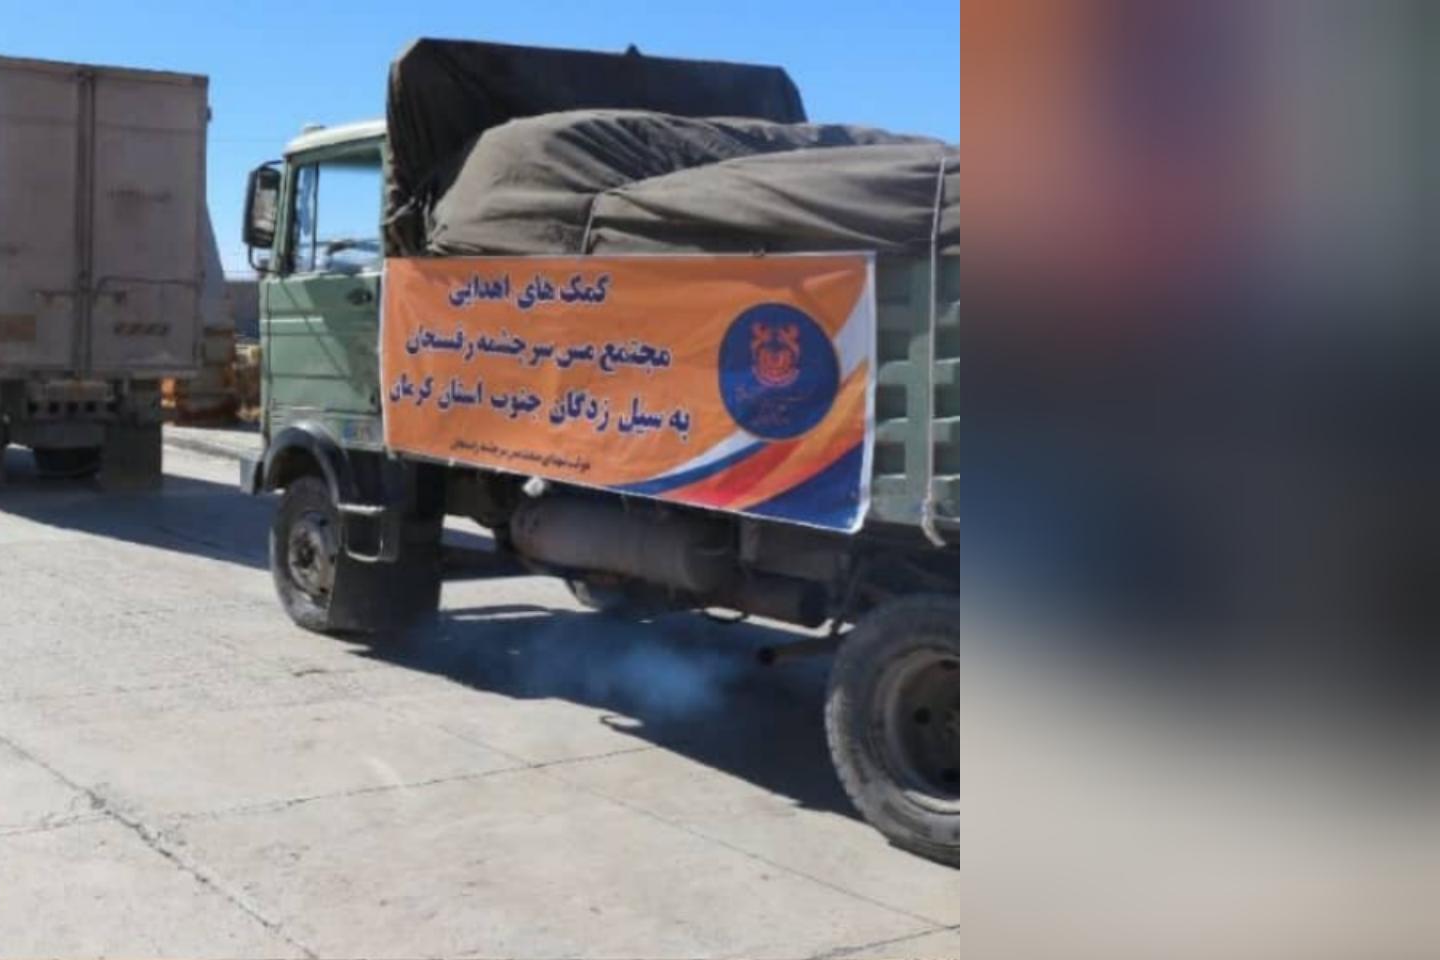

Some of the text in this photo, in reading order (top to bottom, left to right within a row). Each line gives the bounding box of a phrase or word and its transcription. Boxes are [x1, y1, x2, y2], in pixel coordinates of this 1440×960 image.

[448, 274, 610, 309] کمک های اهدایی
[405, 324, 474, 361] رفسنجان
[556, 344, 595, 368] مس
[599, 340, 671, 373] مجتمع
[389, 373, 434, 406] کرمان
[437, 378, 484, 409] استان
[490, 388, 542, 419] جنوب
[617, 397, 663, 433] سیل
[668, 409, 691, 441] به
